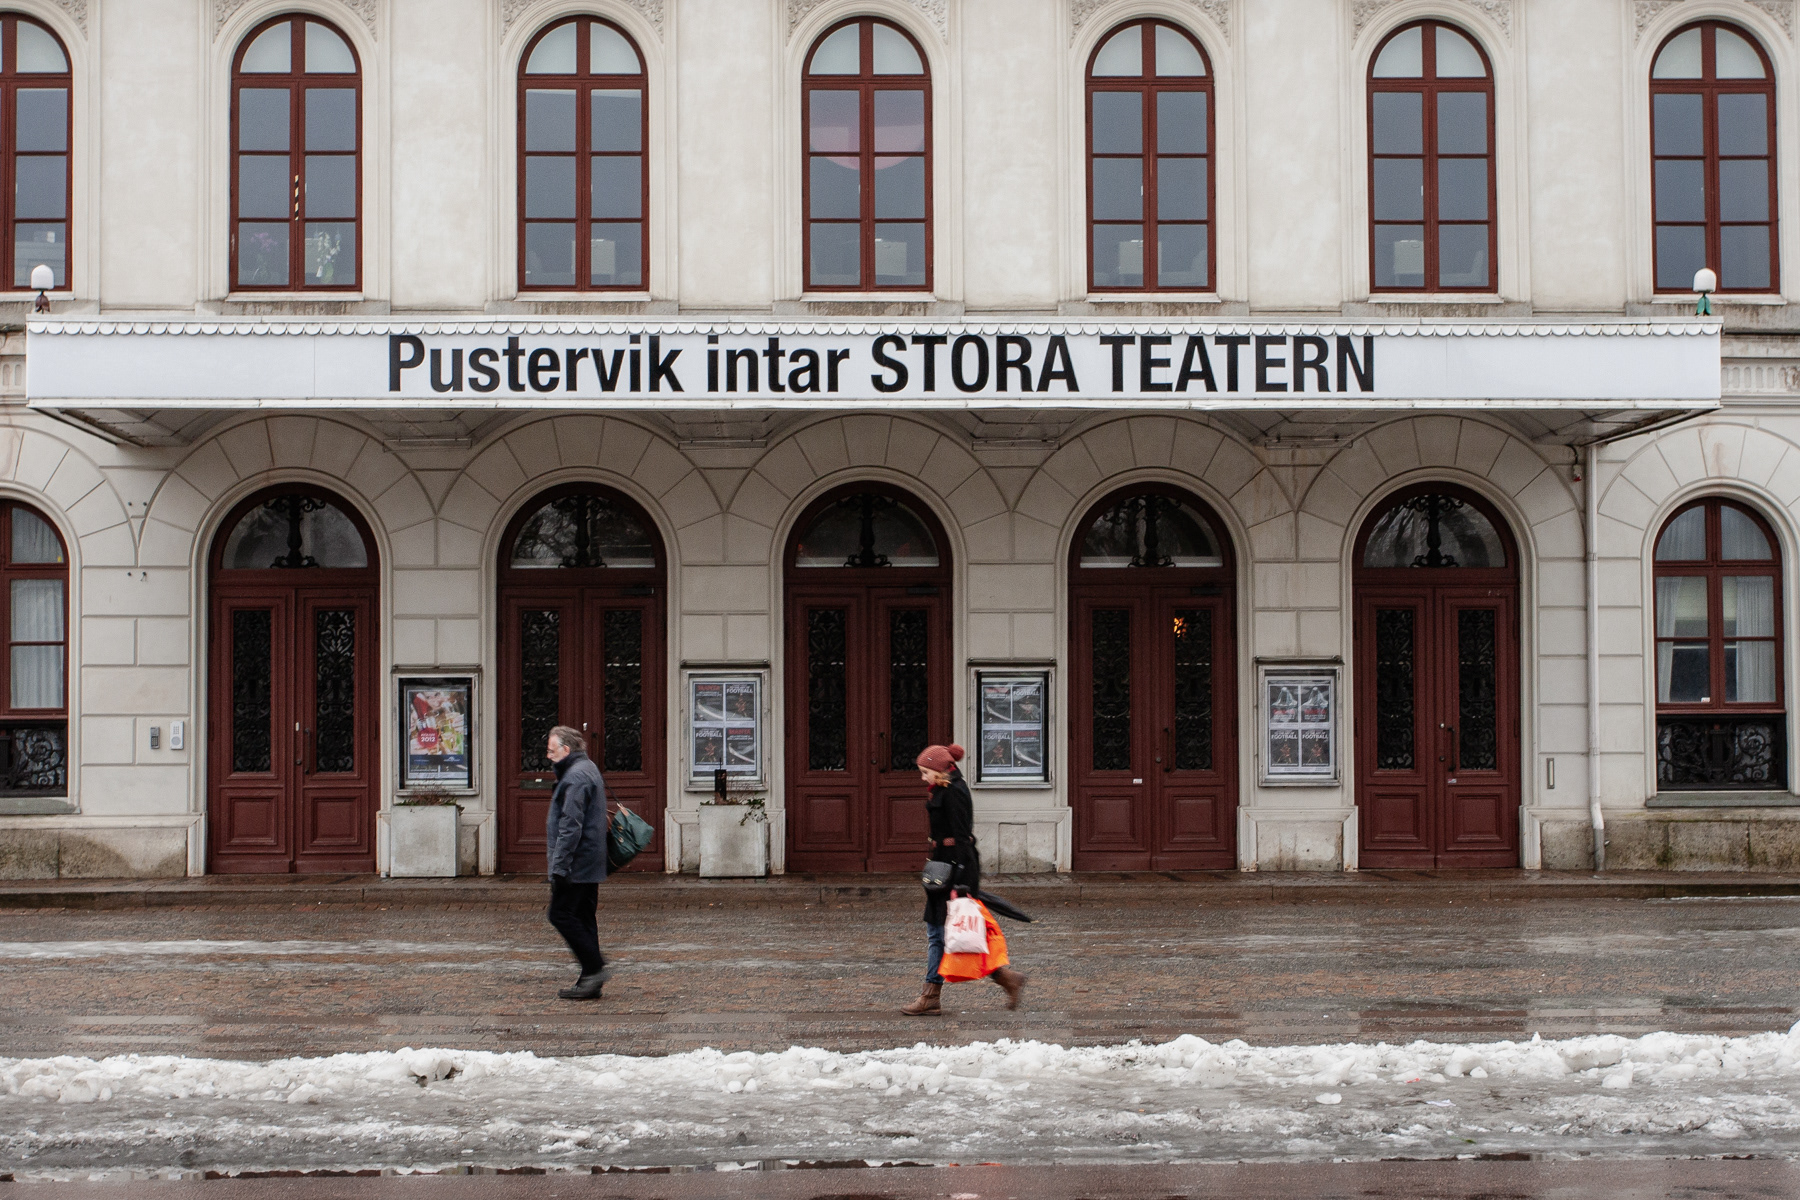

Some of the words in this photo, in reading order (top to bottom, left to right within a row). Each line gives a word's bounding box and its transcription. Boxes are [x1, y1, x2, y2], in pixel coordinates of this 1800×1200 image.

[390, 334, 683, 393] Pustervik
[708, 334, 850, 393] intar
[872, 334, 1080, 394] STORA
[1100, 335, 1375, 393] TEATERN
